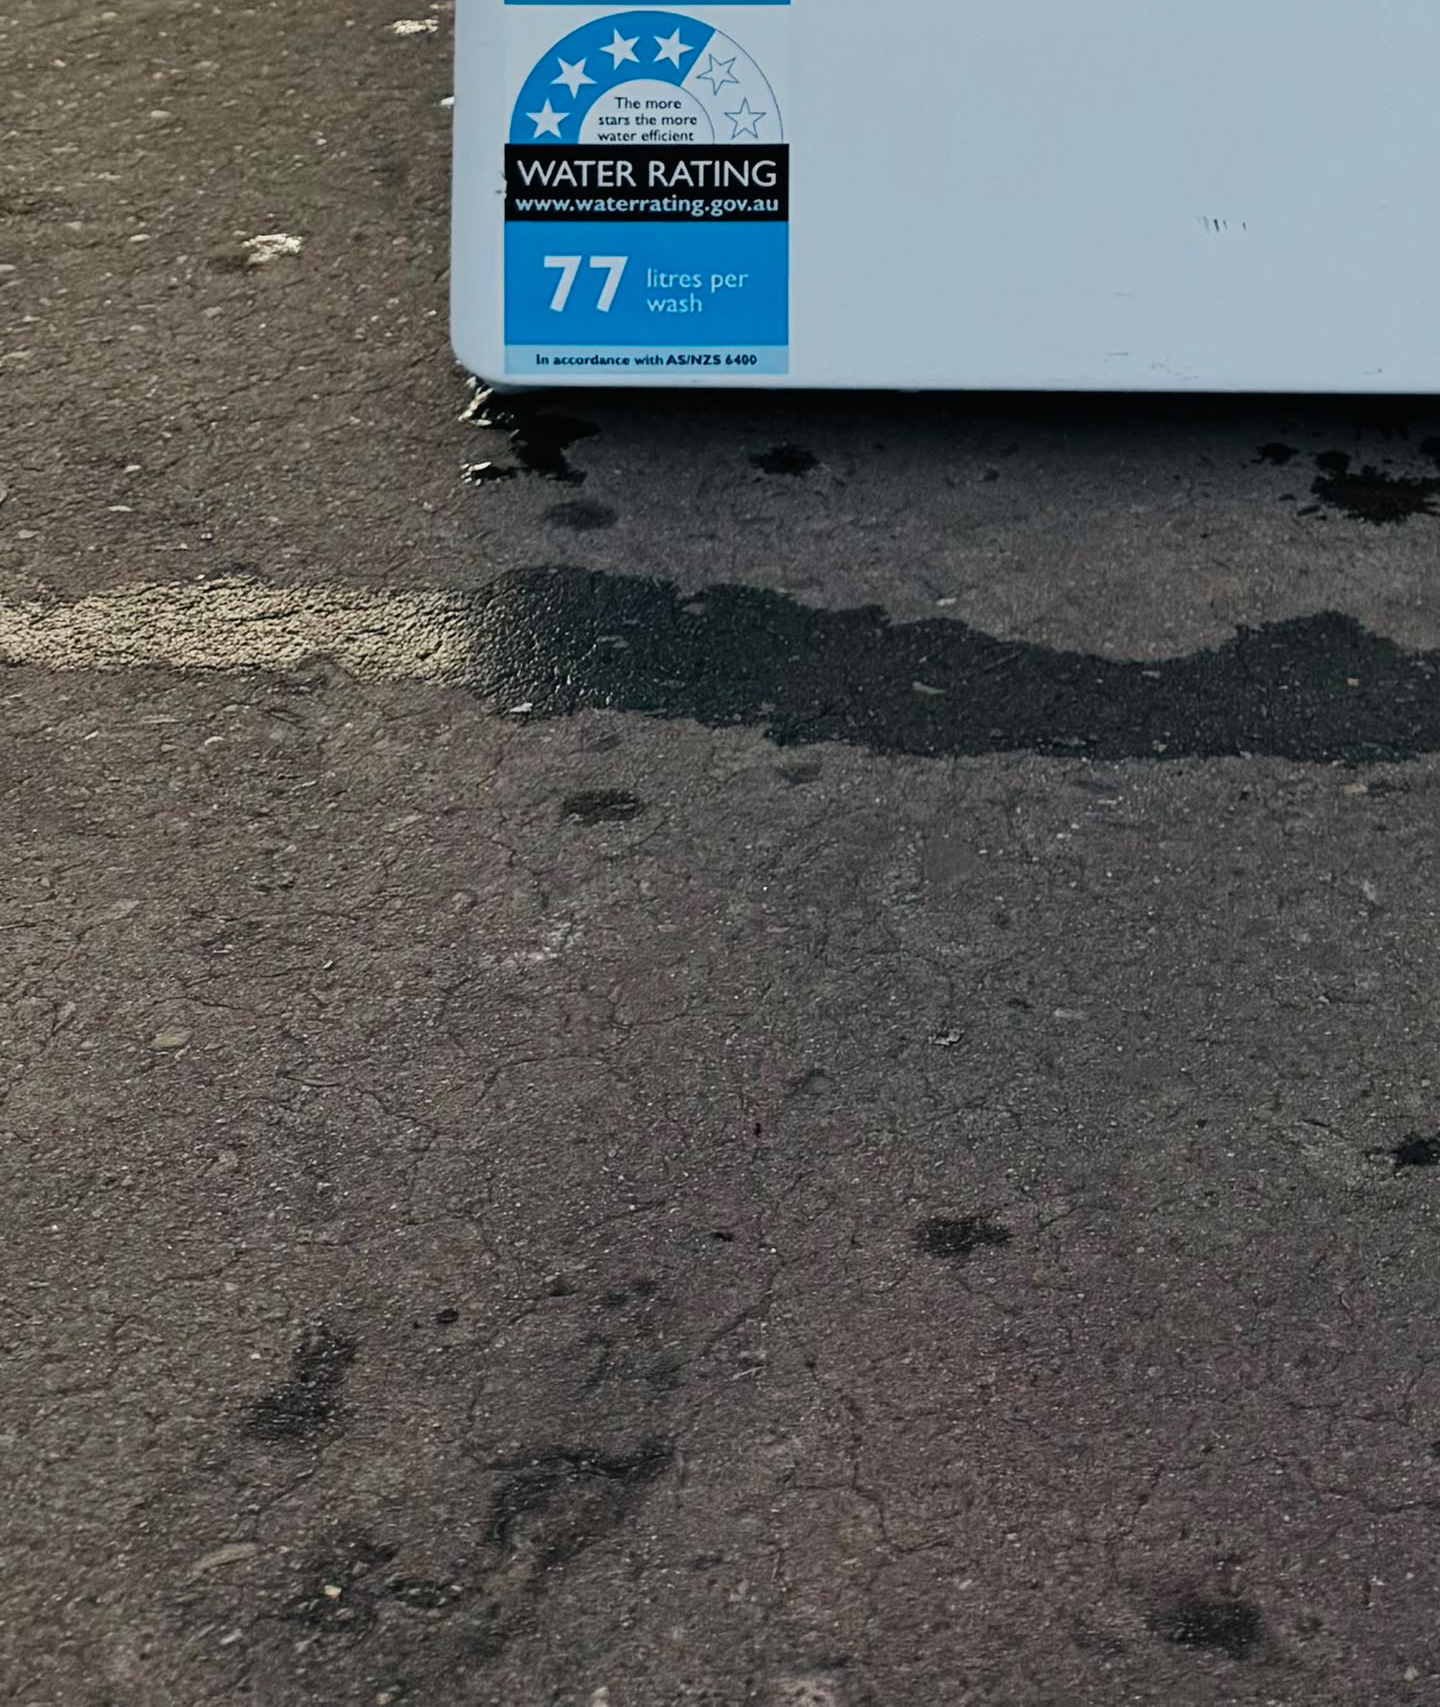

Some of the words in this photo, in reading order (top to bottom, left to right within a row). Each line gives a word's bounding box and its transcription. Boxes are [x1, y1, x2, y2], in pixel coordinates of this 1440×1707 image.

[614, 97, 641, 109] The
[645, 99, 682, 109] more
[598, 115, 631, 127] stars
[635, 114, 657, 127] the
[661, 116, 698, 127] more
[598, 132, 637, 143] water
[641, 130, 694, 143] efficient
[517, 160, 637, 187] WATER
[649, 160, 777, 187] RATING
[515, 195, 779, 217] www.waterrating.gov.au
[544, 255, 628, 313] 77
[646, 268, 702, 289] litres
[710, 273, 749, 293] per
[646, 293, 702, 313] wash
[536, 354, 550, 366] In
[553, 354, 630, 366] accordance
[634, 354, 664, 366] with
[666, 354, 722, 367] AS/NZS
[724, 354, 758, 366] 6400
